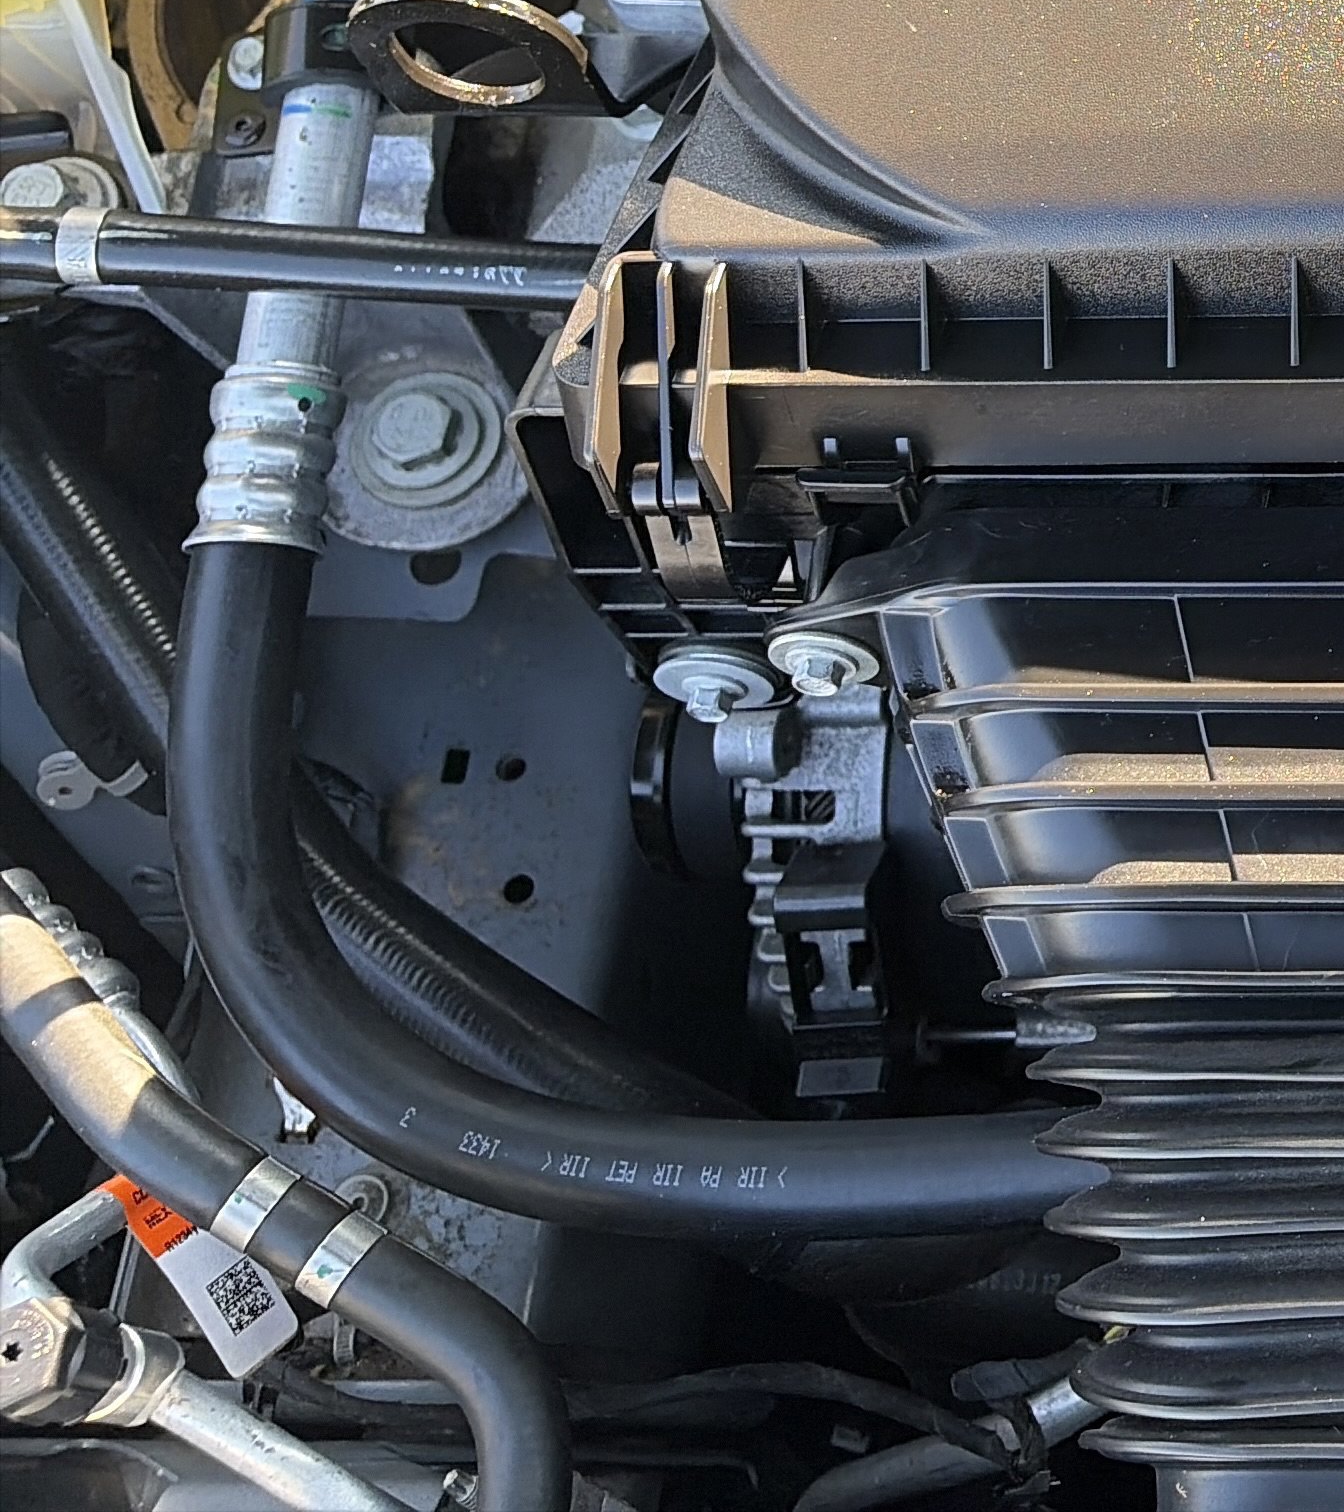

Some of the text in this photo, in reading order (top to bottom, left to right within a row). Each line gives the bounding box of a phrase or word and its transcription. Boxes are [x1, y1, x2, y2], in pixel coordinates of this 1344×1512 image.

[399, 1106, 416, 1129] 3
[458, 1130, 501, 1161] 1433
[559, 1153, 591, 1179] IIR
[605, 1159, 638, 1184] PET
[653, 1162, 684, 1187] IIR
[700, 1164, 723, 1189] PA
[737, 1165, 768, 1189] IIR
